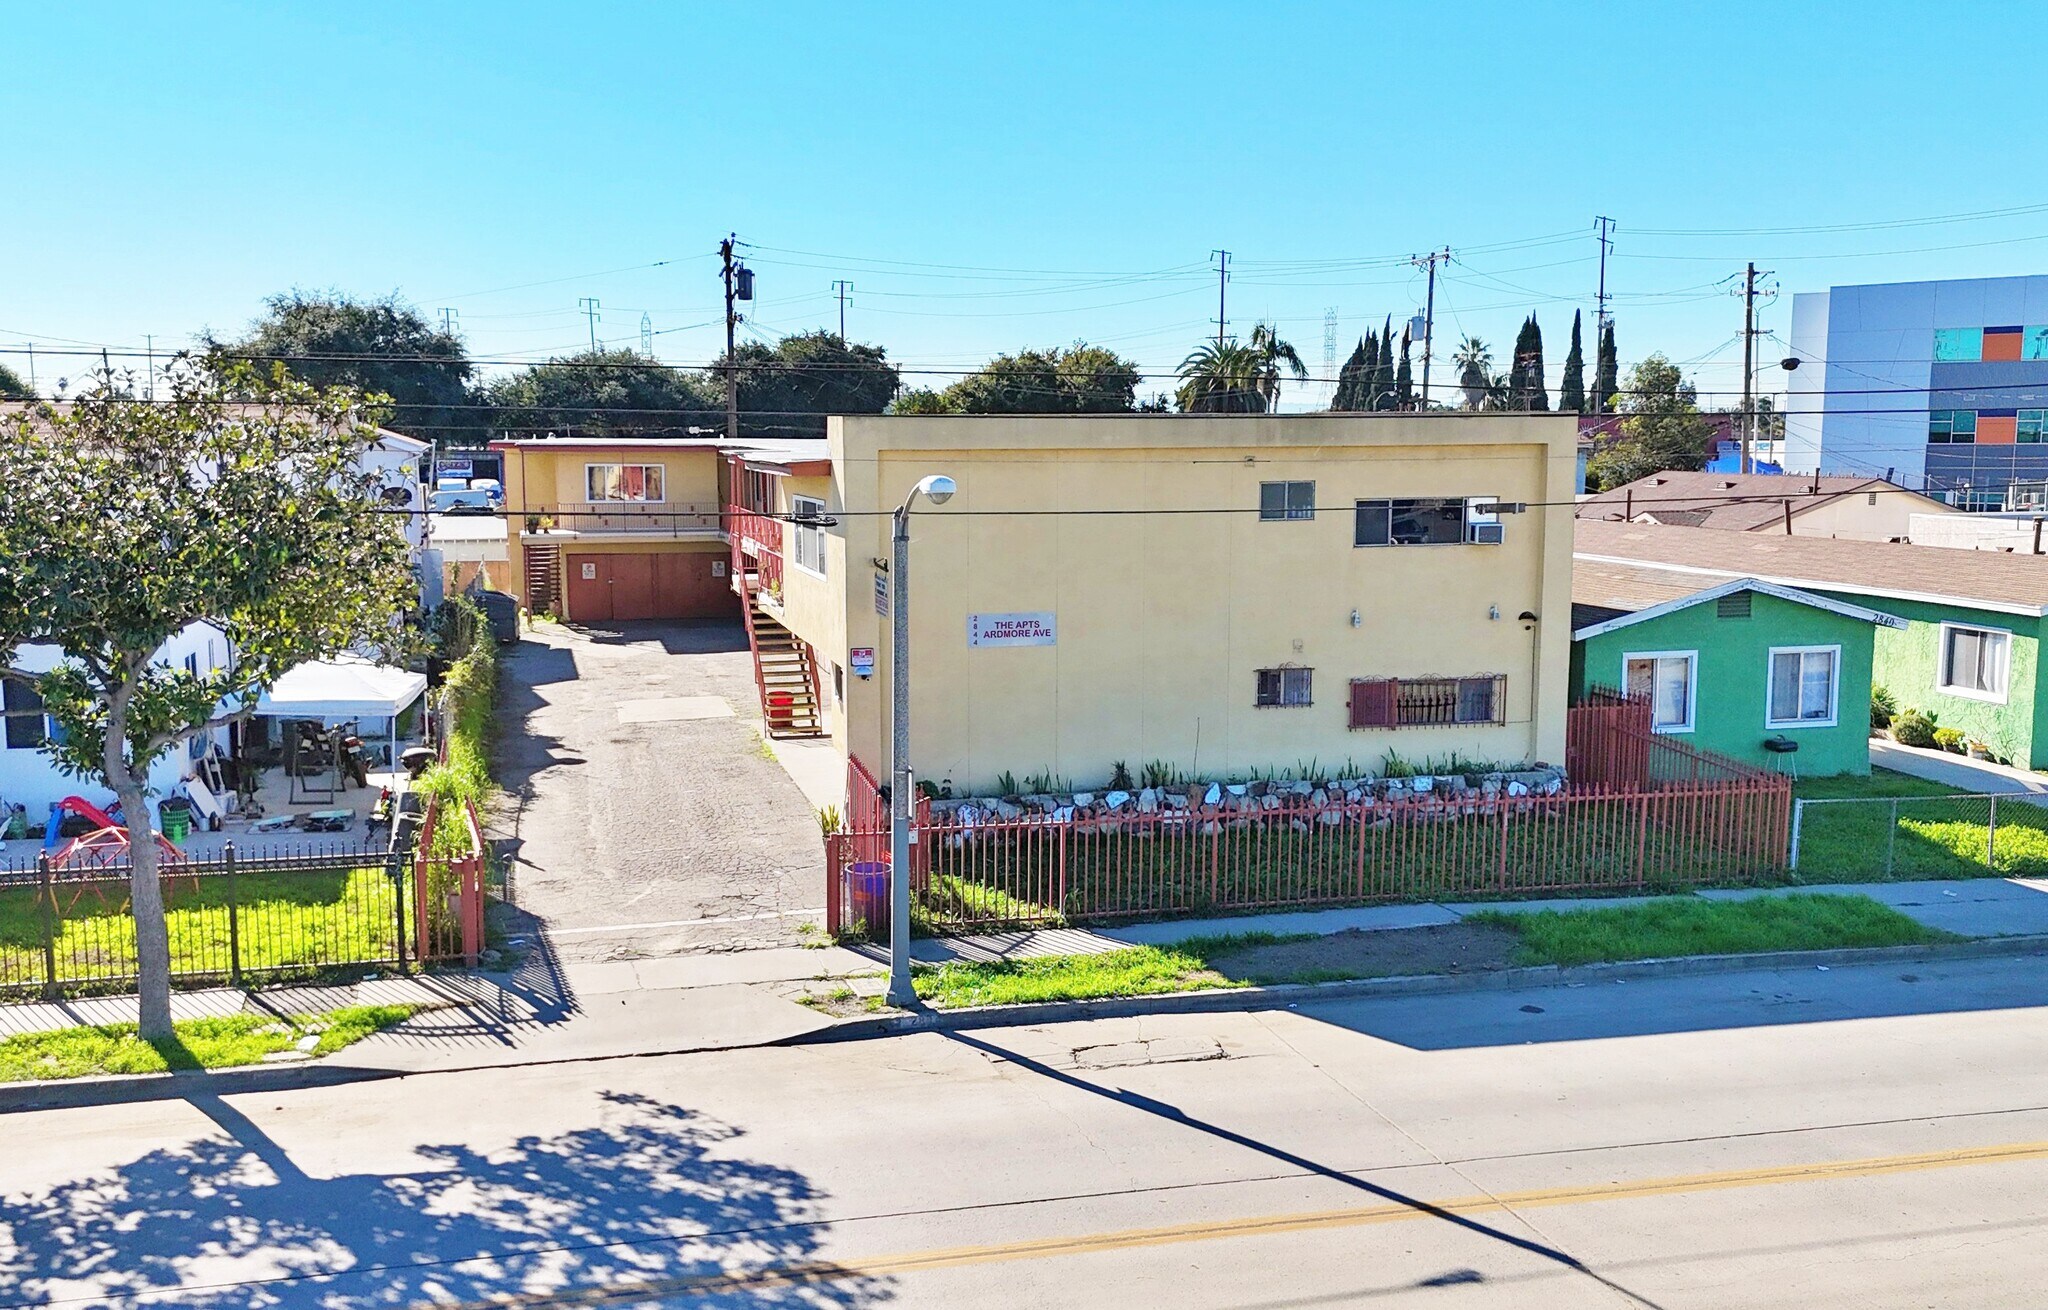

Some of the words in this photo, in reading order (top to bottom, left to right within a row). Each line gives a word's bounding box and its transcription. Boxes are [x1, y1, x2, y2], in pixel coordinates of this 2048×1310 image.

[1873, 613, 1895, 625] 2840
[994, 621, 1014, 630] THE
[1015, 620, 1040, 629] APTS
[983, 630, 1031, 638] ARDMORE
[1033, 628, 1051, 637] AVE
